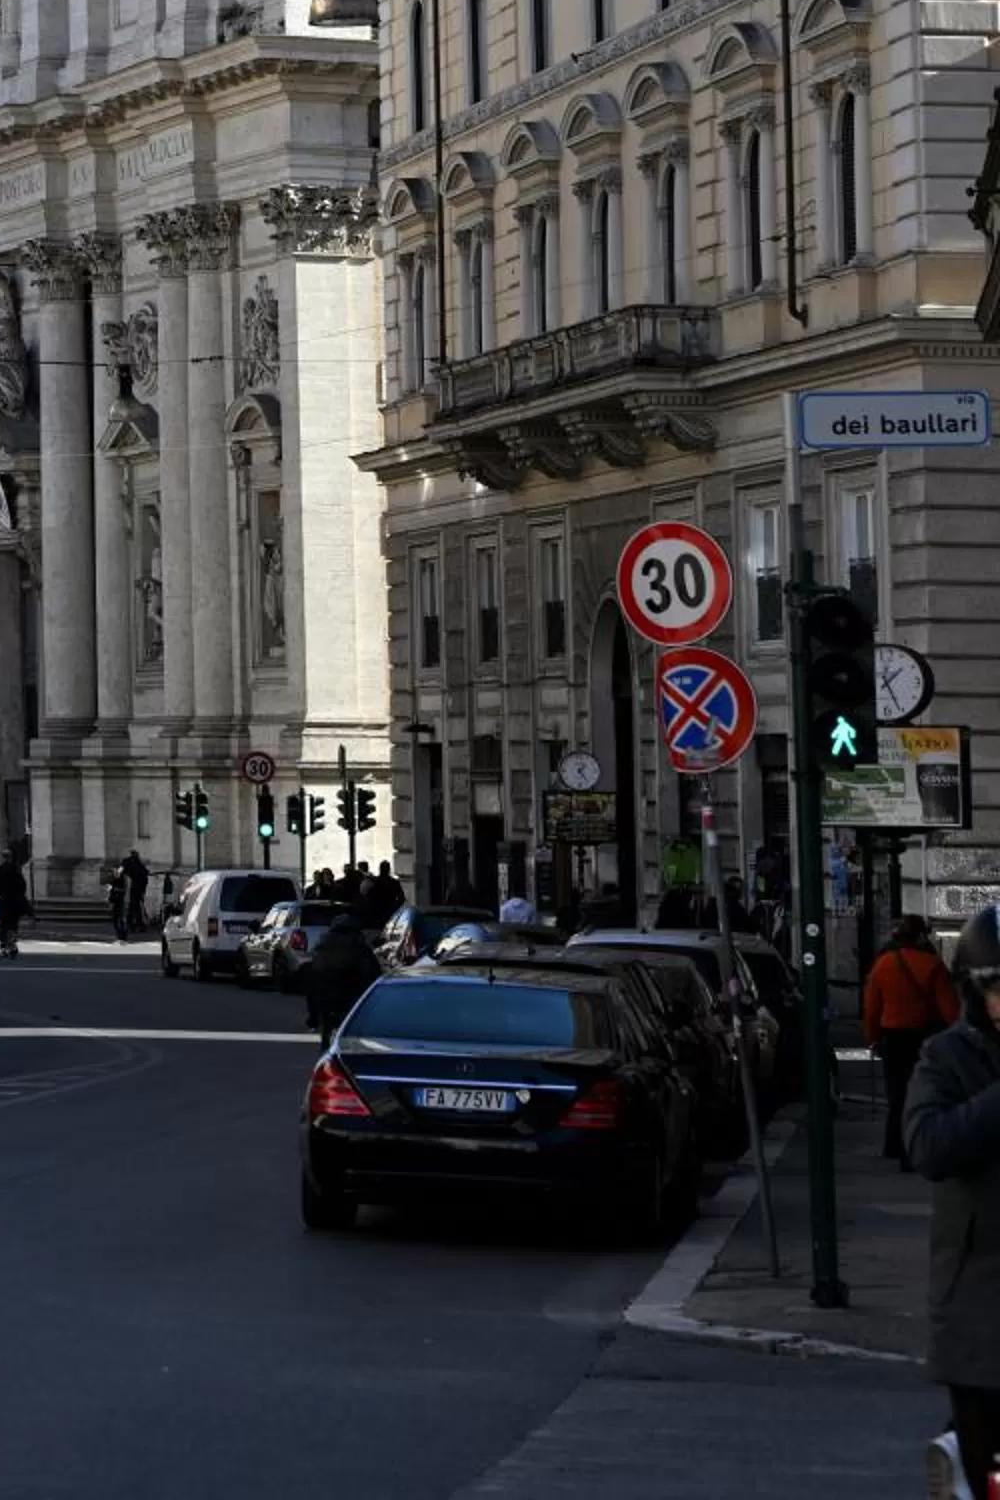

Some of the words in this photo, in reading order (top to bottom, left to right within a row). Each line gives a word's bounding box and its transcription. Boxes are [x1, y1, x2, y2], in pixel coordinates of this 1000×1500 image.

[956, 395, 976, 405] via
[832, 414, 869, 436] dei
[880, 412, 977, 435] baullari
[642, 553, 706, 614] 30
[249, 759, 269, 777] 30
[426, 1088, 445, 1108] FA
